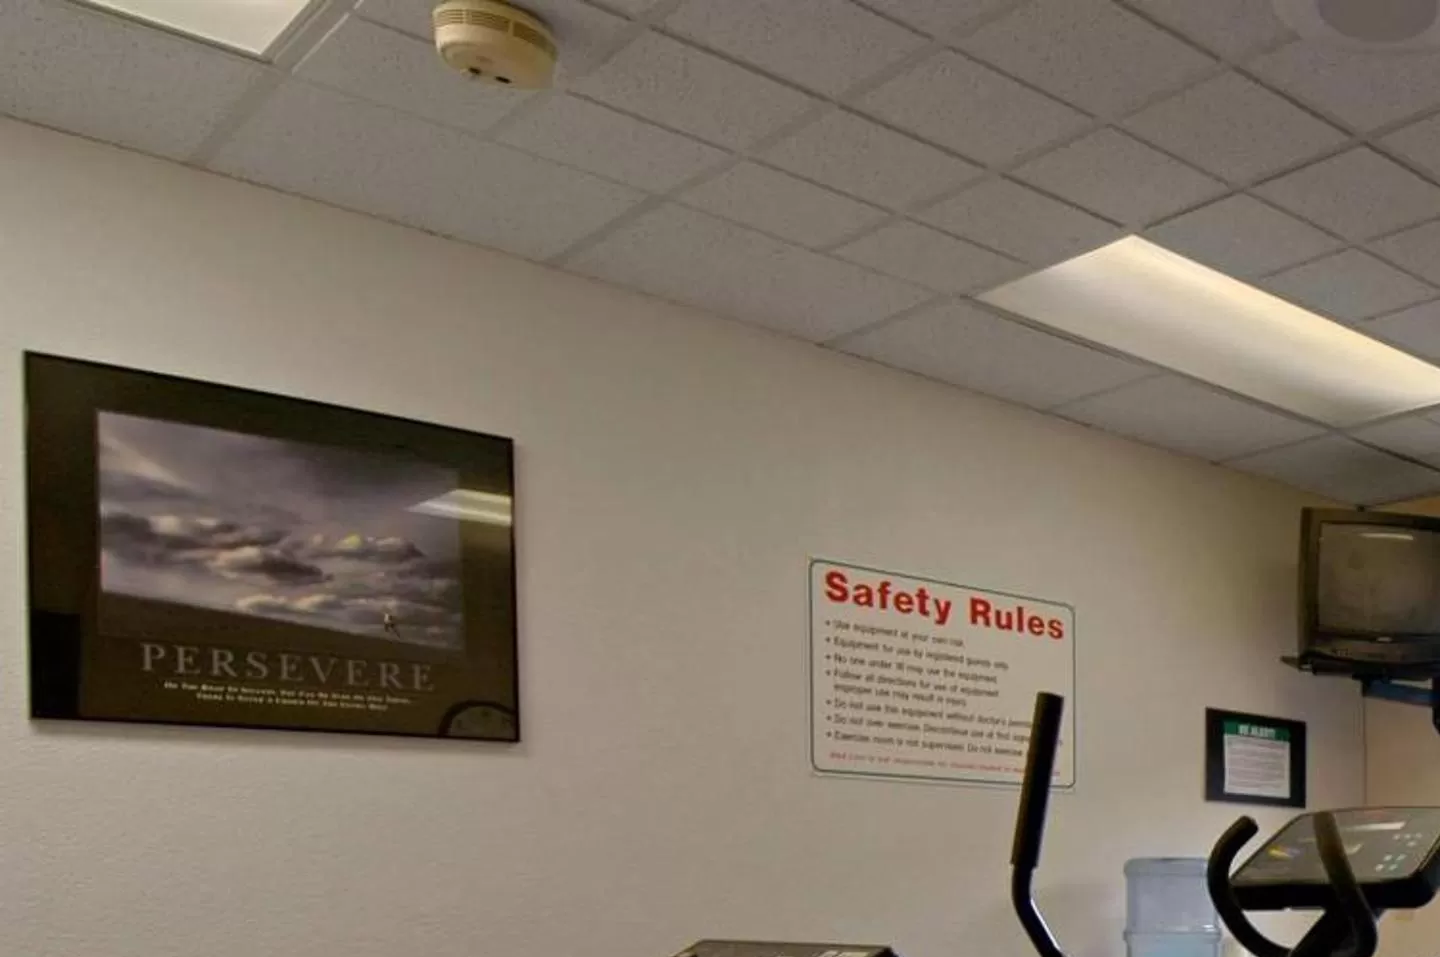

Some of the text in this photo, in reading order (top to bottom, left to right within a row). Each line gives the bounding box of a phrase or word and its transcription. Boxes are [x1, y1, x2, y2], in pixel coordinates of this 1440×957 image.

[825, 570, 1064, 640] Safety Rules
[139, 643, 435, 691] PERSEVERE
